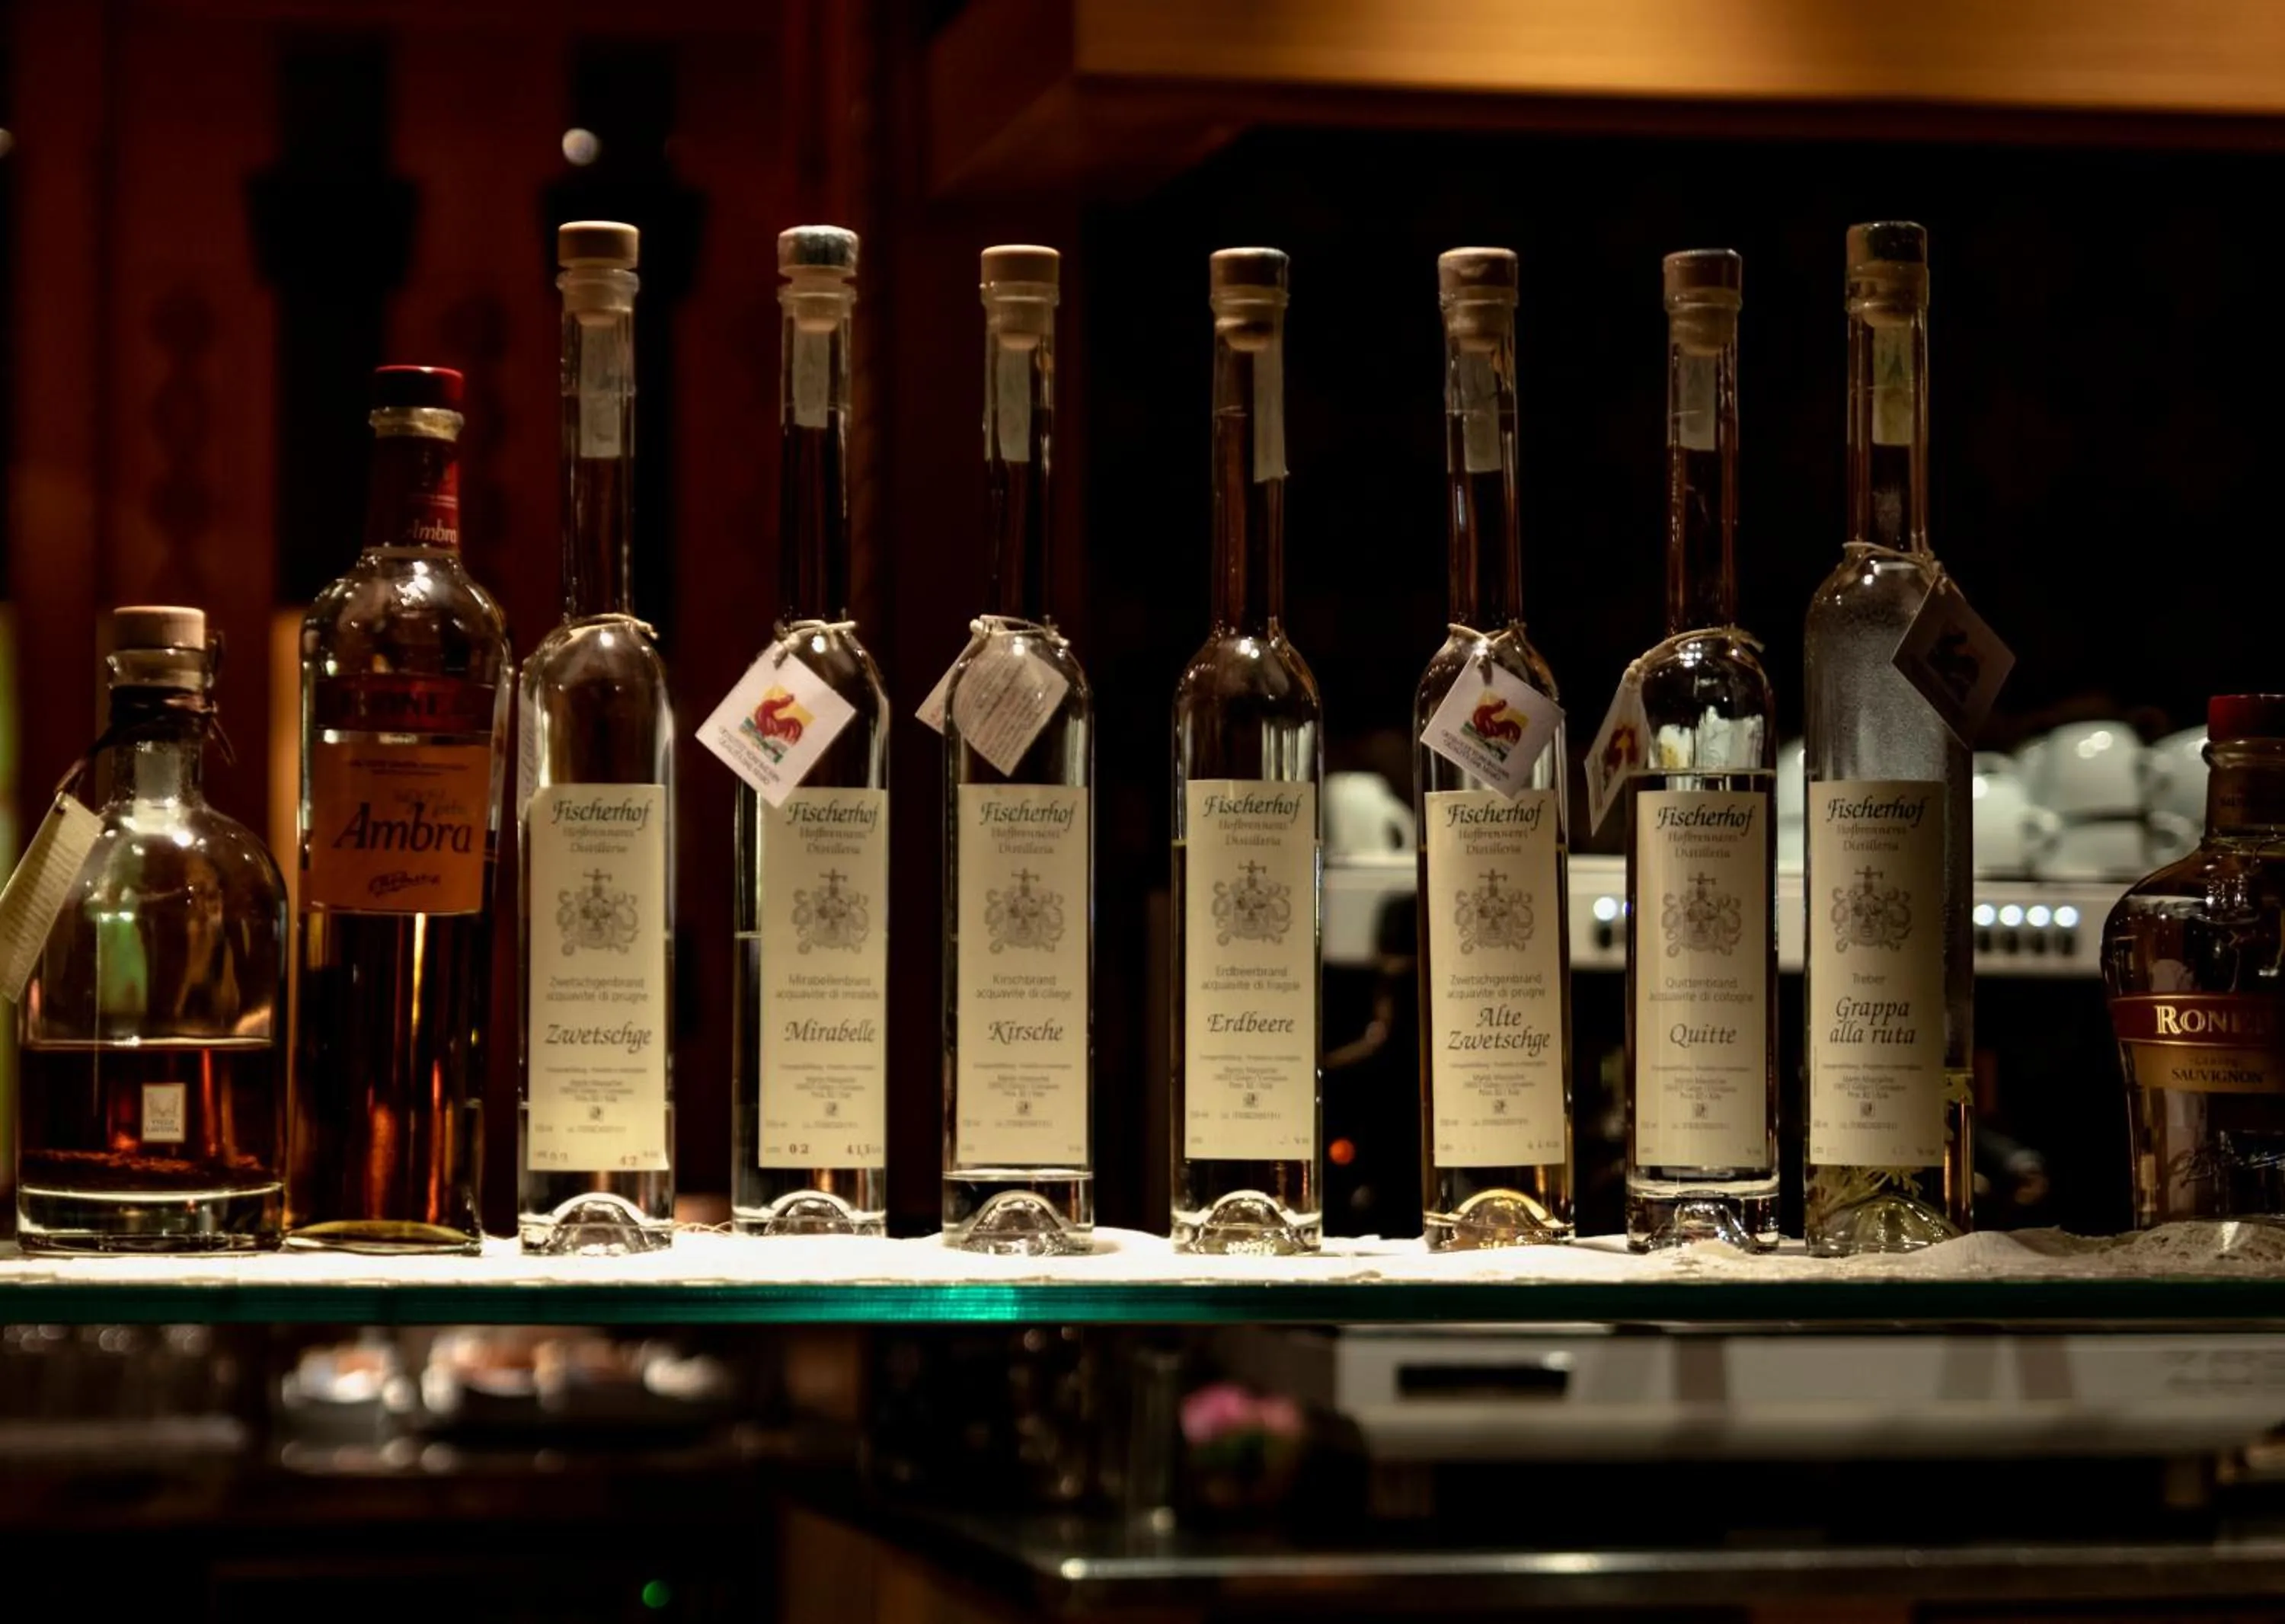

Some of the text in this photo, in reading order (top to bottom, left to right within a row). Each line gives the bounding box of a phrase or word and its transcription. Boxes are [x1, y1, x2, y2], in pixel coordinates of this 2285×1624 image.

[550, 798, 654, 831] Fischerhof
[785, 798, 880, 833] Fischerhof
[979, 798, 1078, 833] Fischerhof
[1203, 791, 1303, 824] Fischerhof
[1446, 799, 1545, 831] Fischerhof
[1655, 804, 1756, 837] Fischerhof
[1826, 794, 1932, 828] Fischerhof
[331, 801, 473, 855] Ambra
[1852, 973, 1886, 985] Treber
[1207, 1012, 1295, 1033] Erdbeere
[1476, 1004, 1522, 1028] Alte
[1836, 996, 1910, 1026] Grappa
[545, 1021, 652, 1053] Zwetschge
[784, 1018, 876, 1042] Mirabelle
[987, 1018, 1063, 1045] Kirsche
[1447, 1025, 1551, 1057] Zwetschge
[1670, 1023, 1737, 1049] Quitte
[1830, 1020, 1916, 1044] alla ruta
[2172, 1069, 2264, 1083] SAUVIGNON
